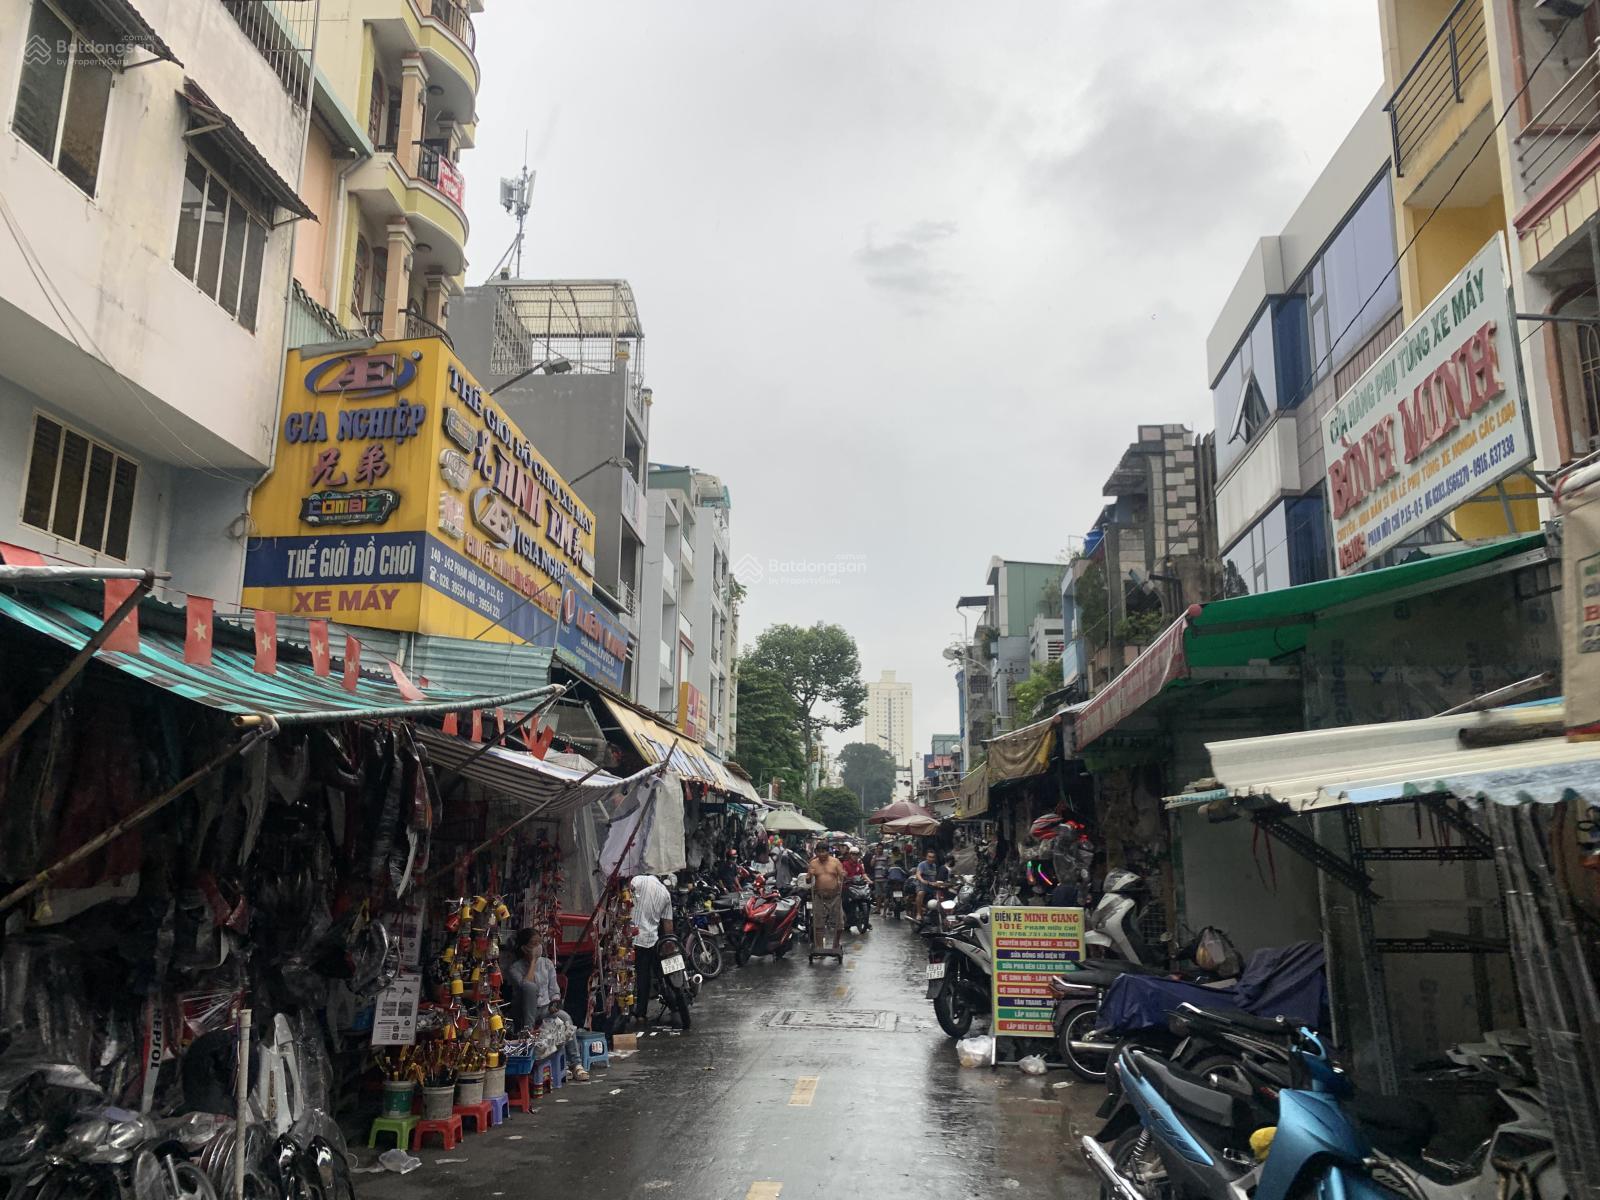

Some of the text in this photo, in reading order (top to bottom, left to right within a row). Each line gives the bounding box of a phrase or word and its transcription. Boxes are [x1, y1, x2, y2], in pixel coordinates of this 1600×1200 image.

[1433, 309, 1452, 347] XE
[1451, 269, 1486, 327] MÁY
[448, 365, 482, 417] THẾ
[285, 397, 426, 445] GIA NGHIỆP
[1327, 320, 1506, 520] BÌNH MINH
[492, 444, 541, 527] ANH
[545, 499, 575, 558] EM
[287, 536, 417, 579] THẾ GIỚI ĐỒ CHƠI
[293, 584, 401, 613] XE MÁY
[1013, 912, 1022, 922] XE
[1024, 913, 1048, 923] MINH
[1051, 913, 1079, 923] GIANG
